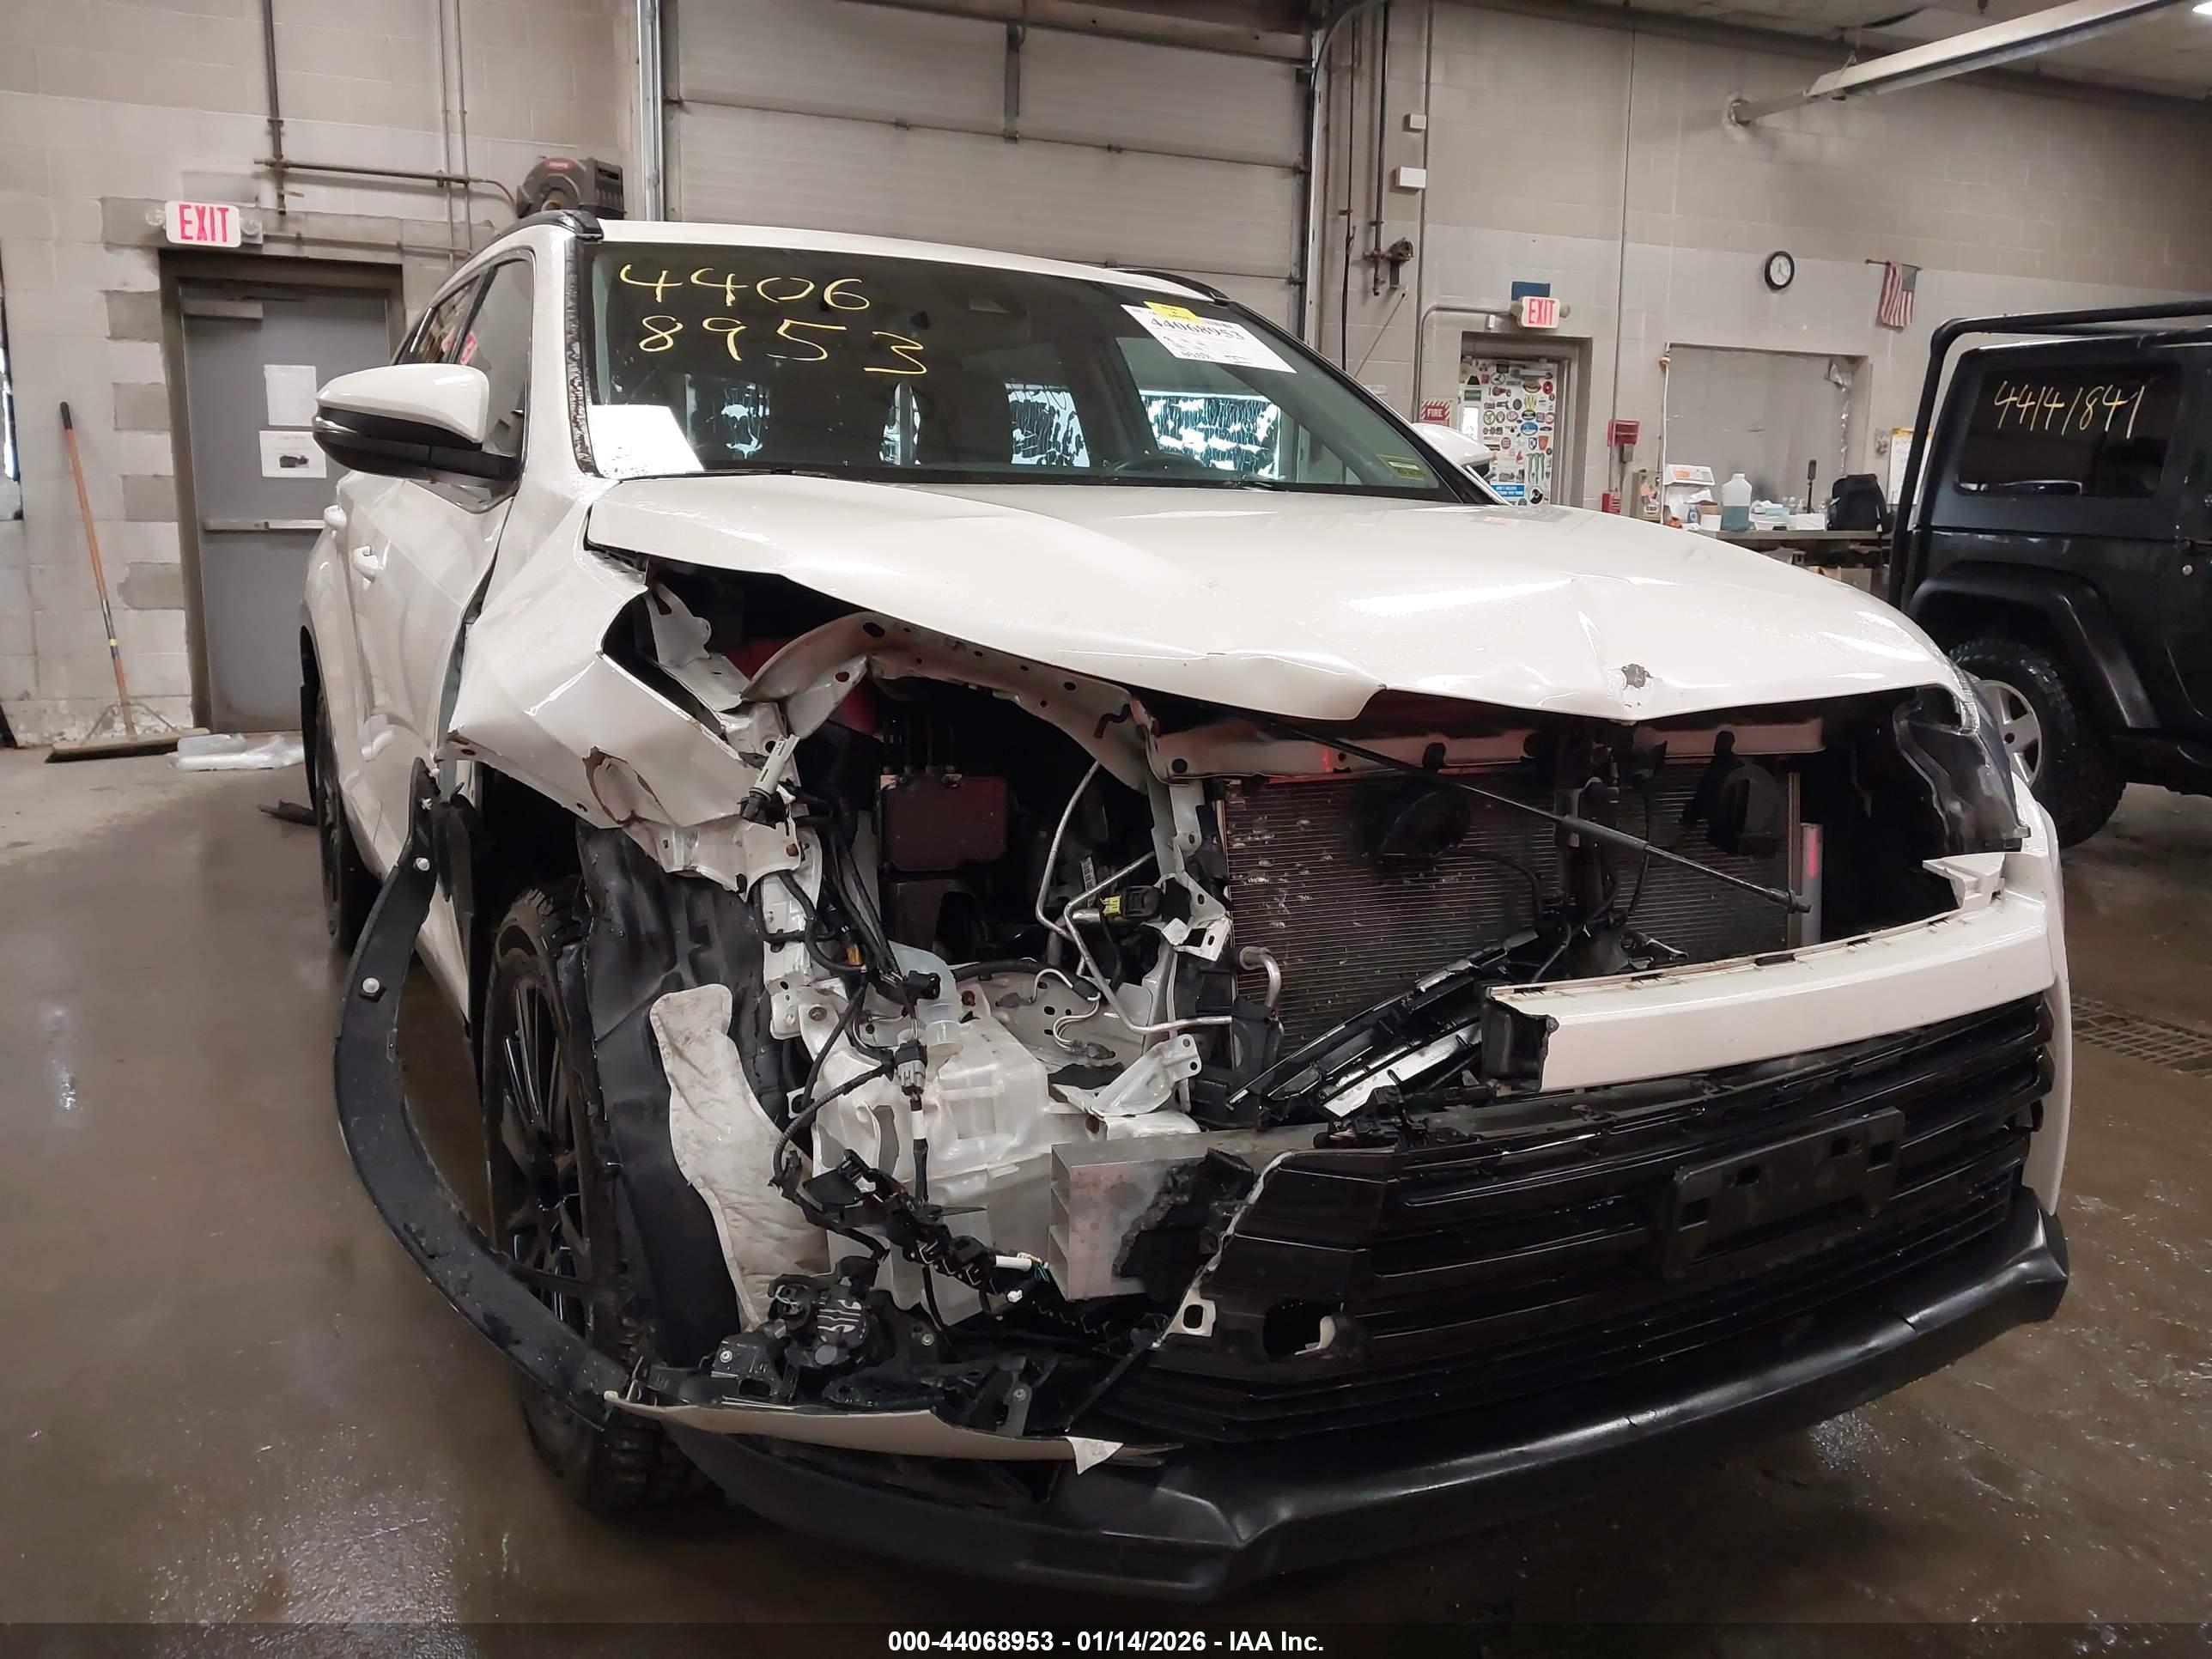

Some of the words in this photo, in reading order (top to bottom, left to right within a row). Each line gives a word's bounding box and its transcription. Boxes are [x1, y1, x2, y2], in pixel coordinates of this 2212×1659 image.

[179, 204, 228, 242] EXIT
[619, 263, 870, 310] 4406
[1528, 298, 1555, 325] EXIT
[638, 314, 927, 374] 8953
[1151, 317, 1245, 341] 44068953
[1426, 408, 1443, 417] FIRE
